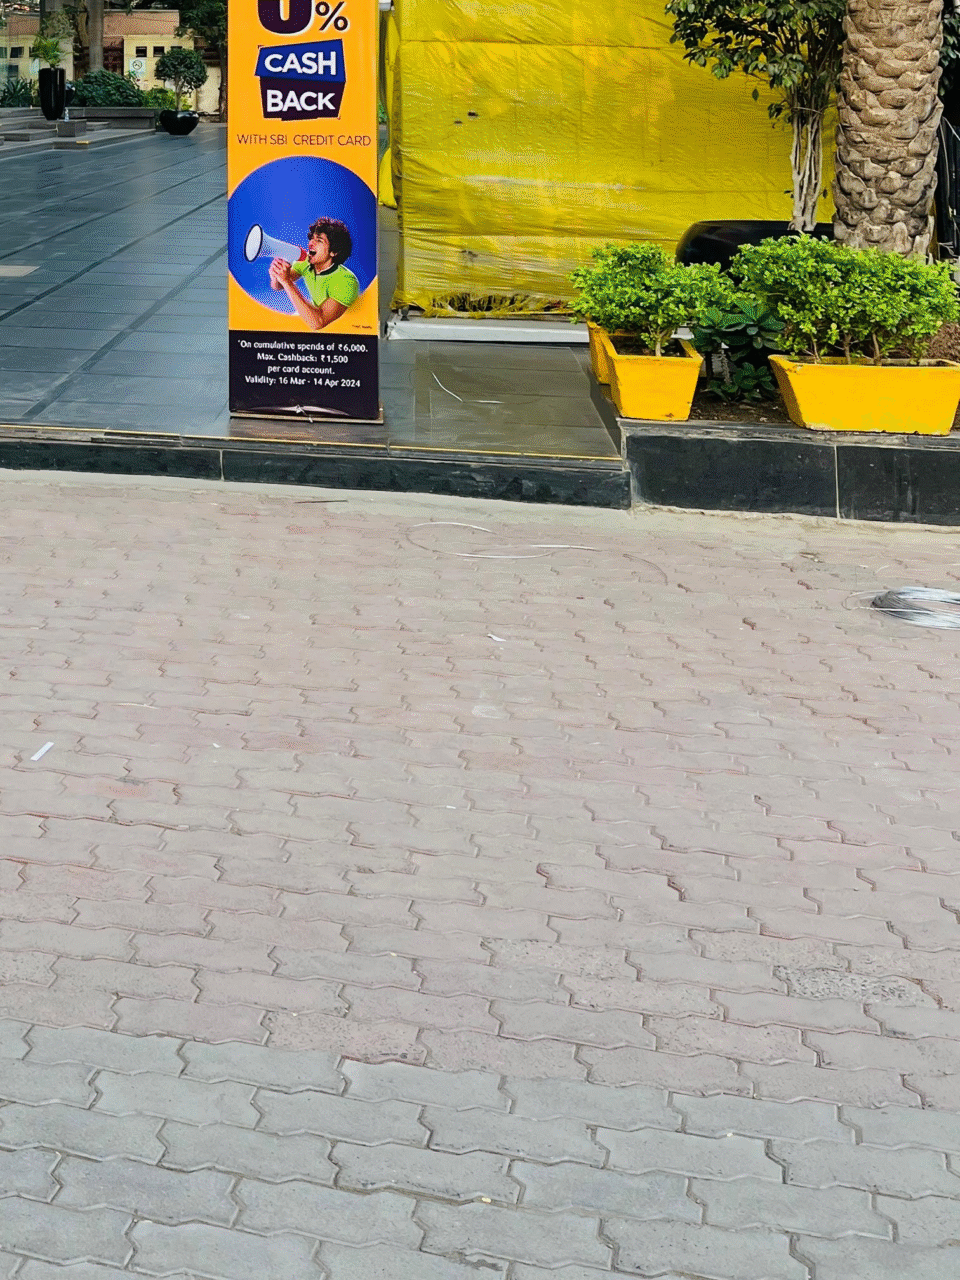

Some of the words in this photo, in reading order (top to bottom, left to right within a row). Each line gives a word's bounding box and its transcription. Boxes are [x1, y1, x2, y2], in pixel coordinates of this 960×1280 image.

[264, 52, 337, 75] CASH
[267, 90, 336, 112] BACK
[237, 134, 268, 146] WITH
[270, 134, 288, 146] SBI
[293, 134, 335, 146] CREDIT
[337, 134, 371, 147] CARD
[253, 341, 296, 349] cumulative
[297, 342, 326, 352] spends
[326, 342, 336, 351] of
[257, 353, 276, 361] Max.
[277, 353, 318, 362] Cashback:
[267, 365, 280, 373] per
[282, 365, 300, 373] card
[301, 366, 335, 375] account.
[245, 375, 277, 386] Validity:
[289, 377, 306, 385] Mar
[313, 377, 323, 386] 14
[324, 379, 339, 388] Apr
[340, 379, 361, 388] 2024
